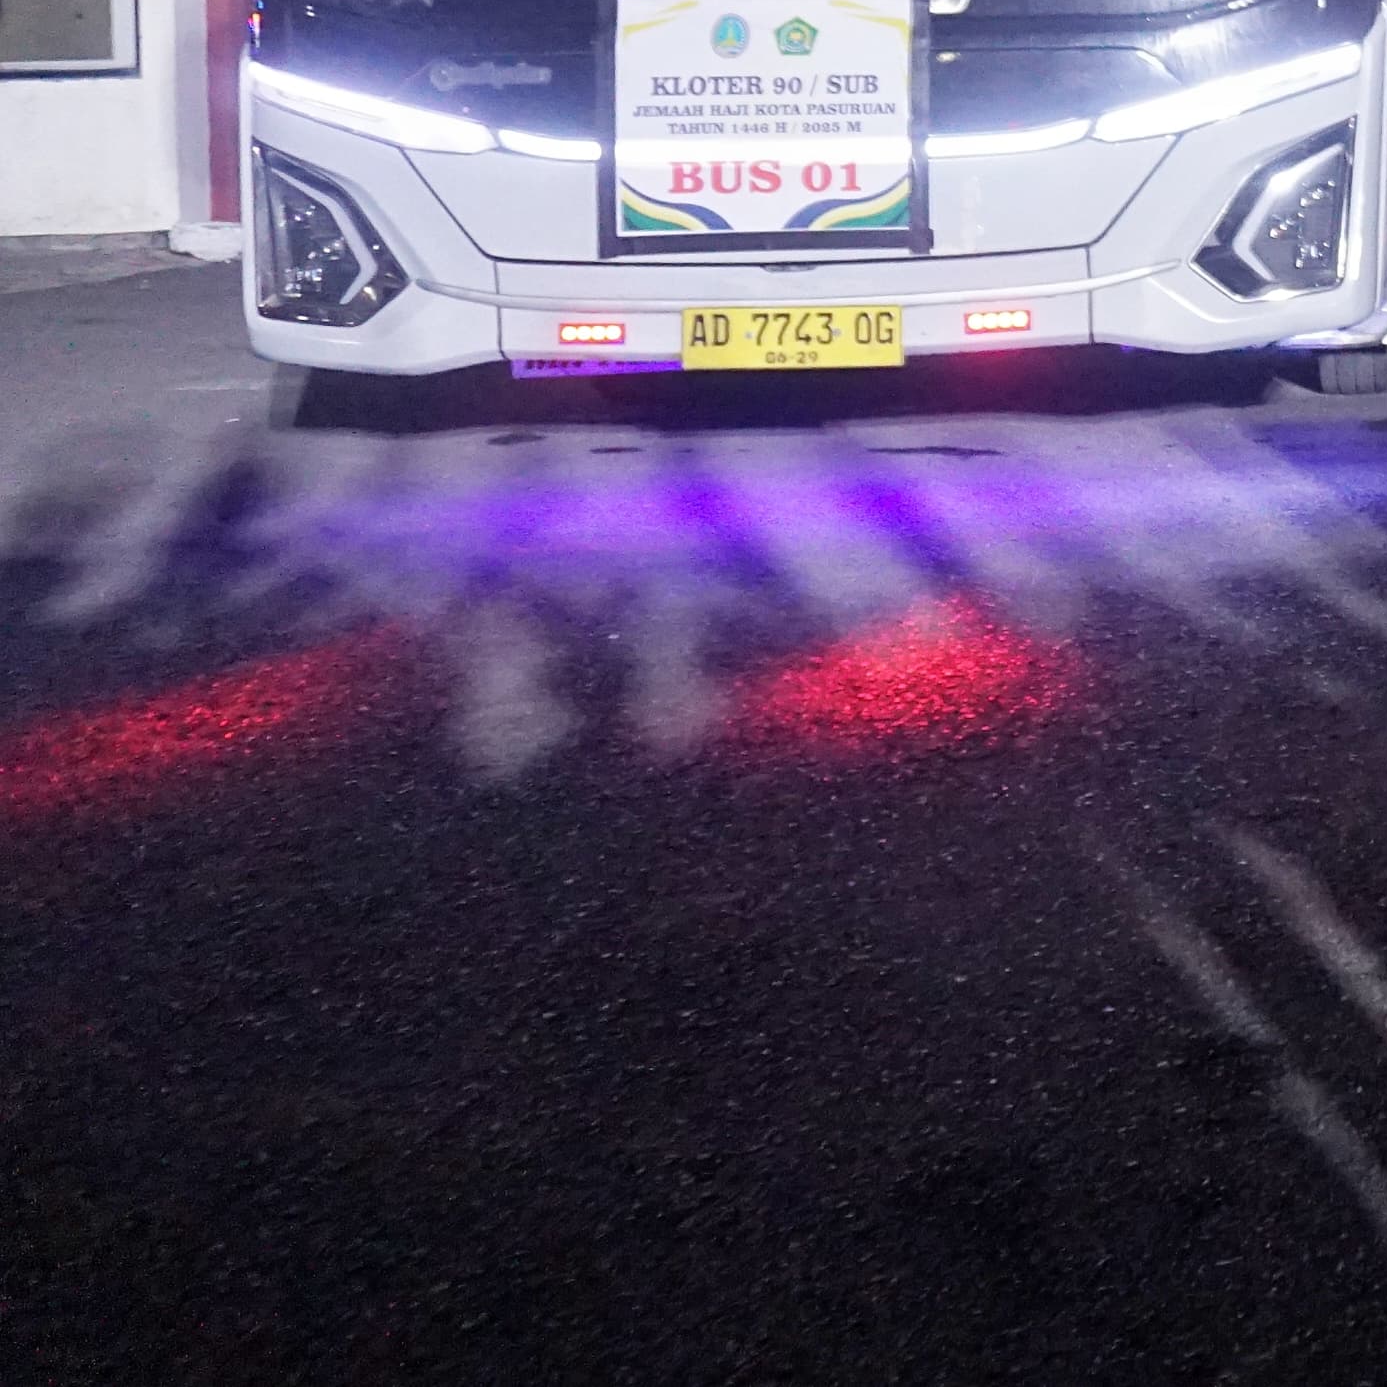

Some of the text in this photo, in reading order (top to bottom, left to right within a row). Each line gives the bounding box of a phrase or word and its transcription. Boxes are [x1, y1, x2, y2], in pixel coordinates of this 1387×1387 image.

[651, 76, 763, 96] KLOTER
[773, 76, 802, 95] 90
[826, 74, 879, 94] SUB
[633, 102, 896, 118] JEMAAH HAJI KOTA PASURUAN
[667, 122, 725, 135] TAHUN
[775, 122, 788, 134] H
[802, 121, 841, 133] 2025
[847, 121, 862, 133] M
[667, 159, 862, 195] BUS 01
[690, 311, 894, 347] AD 7743 OG
